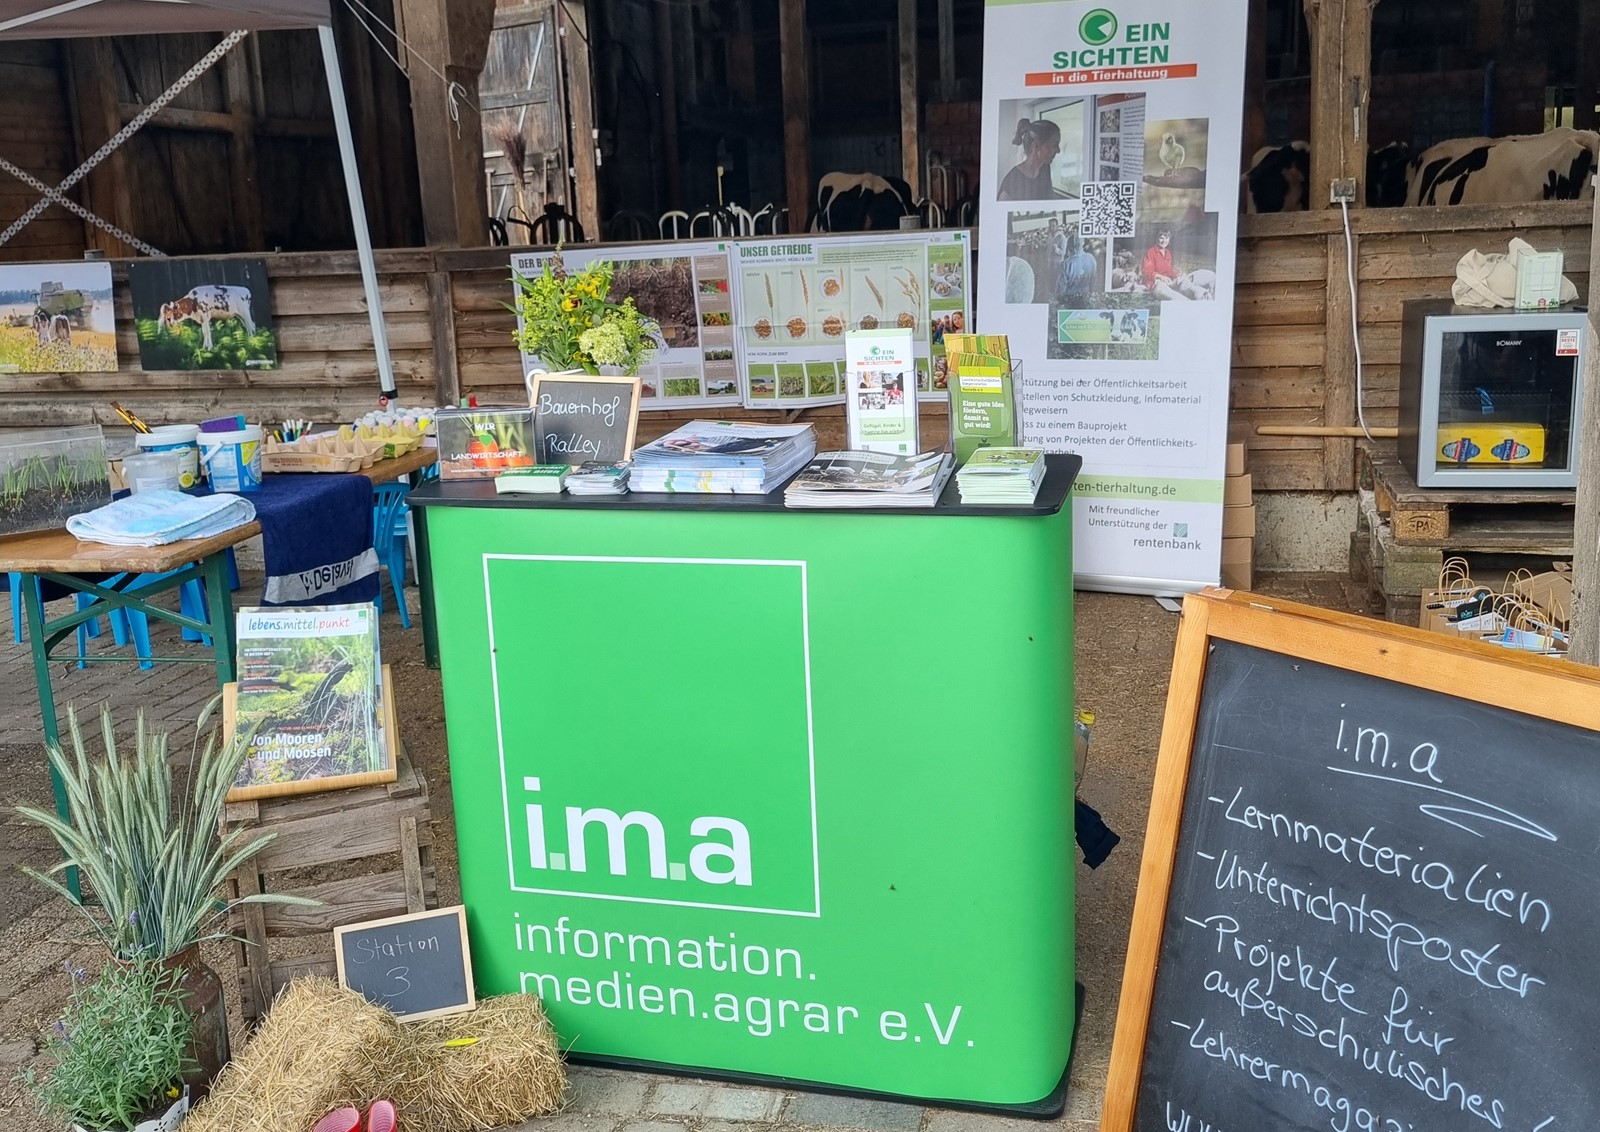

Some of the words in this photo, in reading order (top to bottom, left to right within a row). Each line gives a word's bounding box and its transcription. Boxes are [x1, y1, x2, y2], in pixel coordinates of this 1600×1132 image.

[1126, 22, 1170, 43] EIN
[1053, 45, 1169, 70] SICHTEN
[1052, 73, 1064, 84] in
[1068, 71, 1088, 83] die
[1091, 68, 1168, 81] Tierhaltung
[740, 246, 769, 258] UNSER
[770, 244, 813, 256] GETREIDE
[518, 258, 535, 269] DER
[536, 257, 564, 268] BDN
[1060, 378, 1074, 387] bei
[1076, 378, 1091, 388] der
[1093, 377, 1187, 389] Öffentlichkeitsarbeit
[977, 401, 991, 409] gute
[1053, 393, 1069, 402] von
[1071, 393, 1142, 405] Schutzkleidung,
[1144, 395, 1201, 404] Infomaterial
[539, 393, 620, 427] Bauernhof
[963, 407, 987, 415] fördern,
[474, 422, 496, 431] WIR
[1036, 421, 1046, 429] zu
[1048, 420, 1075, 430] einem
[1078, 421, 1127, 433] Bauprojekt
[546, 432, 601, 461] Ralley
[1046, 436, 1062, 444] von
[1064, 435, 1106, 447] Projekten
[1109, 436, 1124, 445] der
[1127, 435, 1197, 448] Öffentlichkeits-
[451, 451, 523, 460] LANDWIRTSCHAFT
[1088, 505, 1104, 514] Mit
[1106, 505, 1160, 517] freundlicher
[1088, 518, 1150, 530] Unterstützung
[1152, 521, 1168, 530] der
[1133, 538, 1202, 550] rentenbank
[248, 617, 350, 632] lebens.mittel.punkt
[275, 732, 322, 745] Mooren
[257, 748, 281, 760] und
[284, 747, 332, 759] Moosen
[523, 776, 752, 886] i.m.a
[352, 934, 440, 964] Station
[513, 912, 817, 981] information.
[381, 966, 411, 997] 3
[519, 970, 859, 1038] medien.agrar
[879, 1002, 974, 1047] e.V.
[1383, 986, 1455, 1055] für
